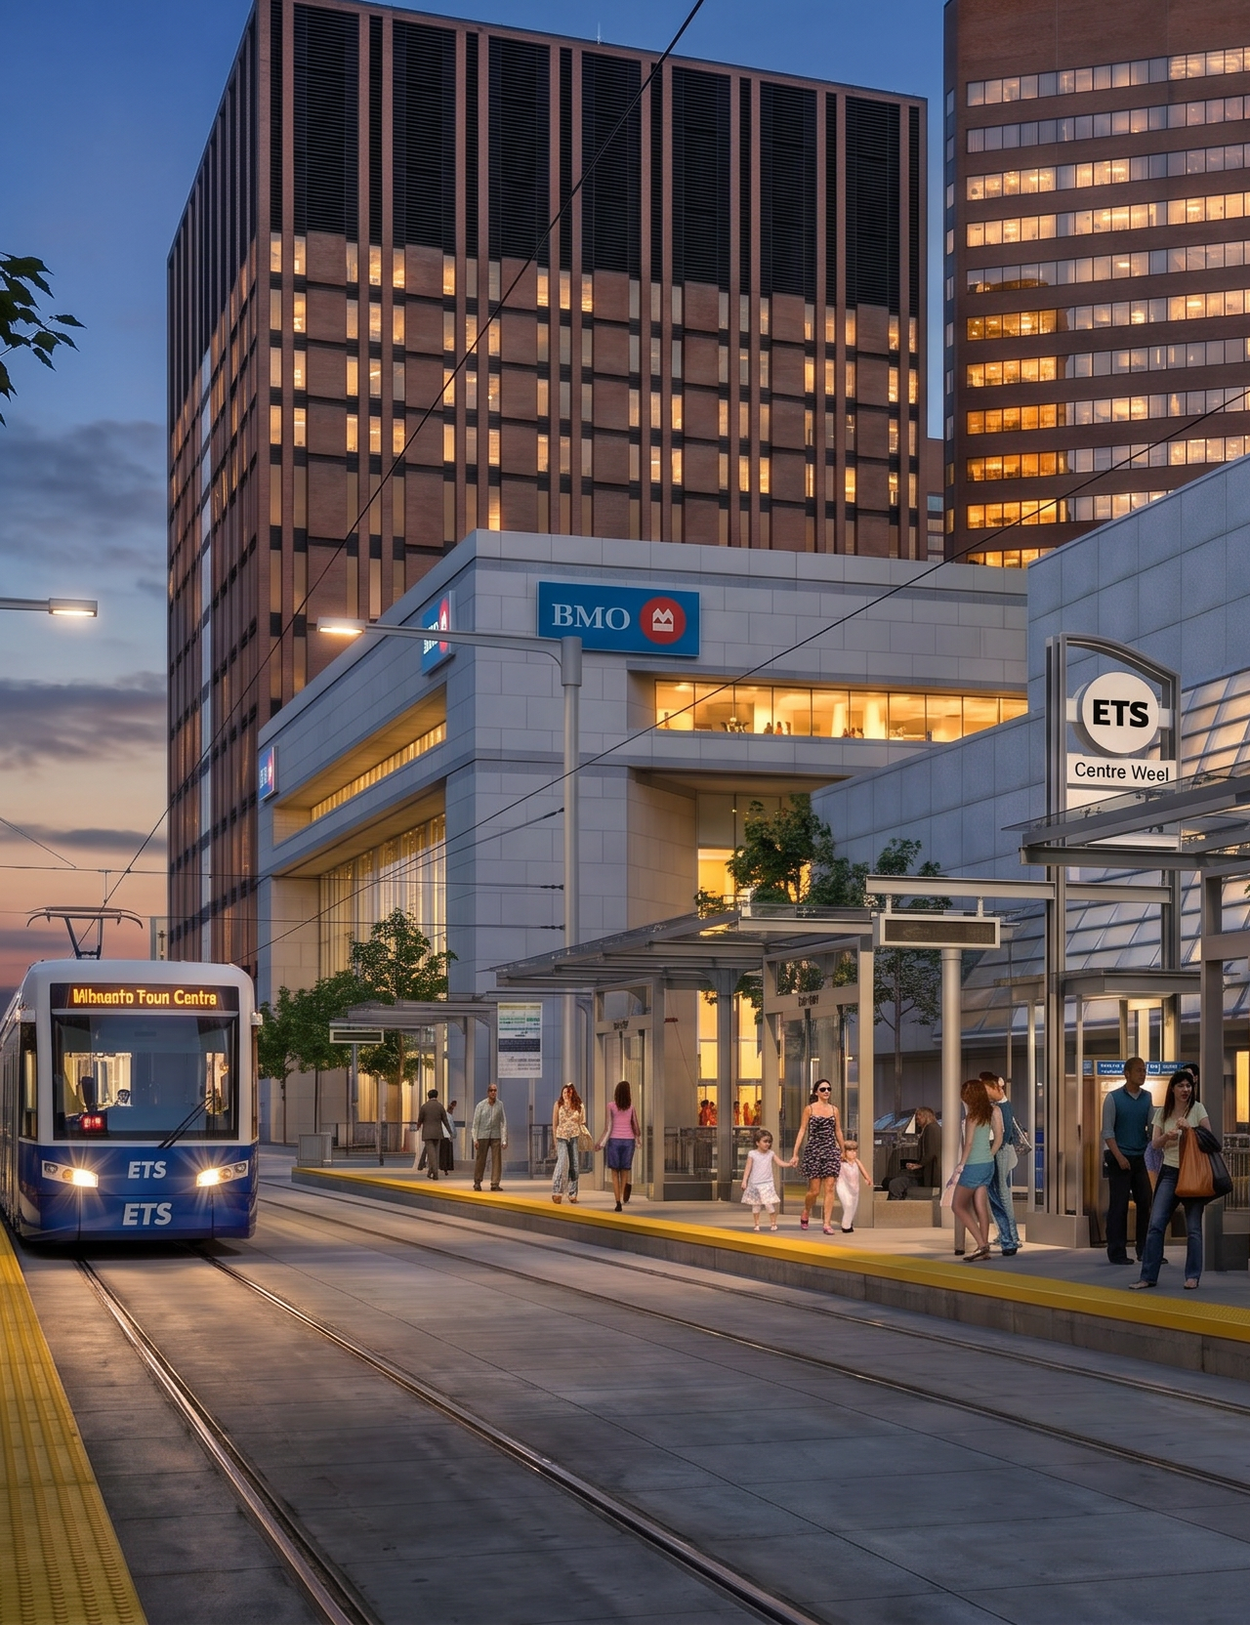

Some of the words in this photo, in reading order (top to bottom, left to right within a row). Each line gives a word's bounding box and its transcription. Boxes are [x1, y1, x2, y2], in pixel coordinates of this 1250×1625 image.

[551, 603, 631, 630] BMO
[1093, 699, 1149, 728] ETS
[1075, 761, 1126, 779] Centre
[1131, 765, 1169, 782] Weel
[128, 1161, 167, 1179] ETS
[122, 1202, 172, 1226] ETS
